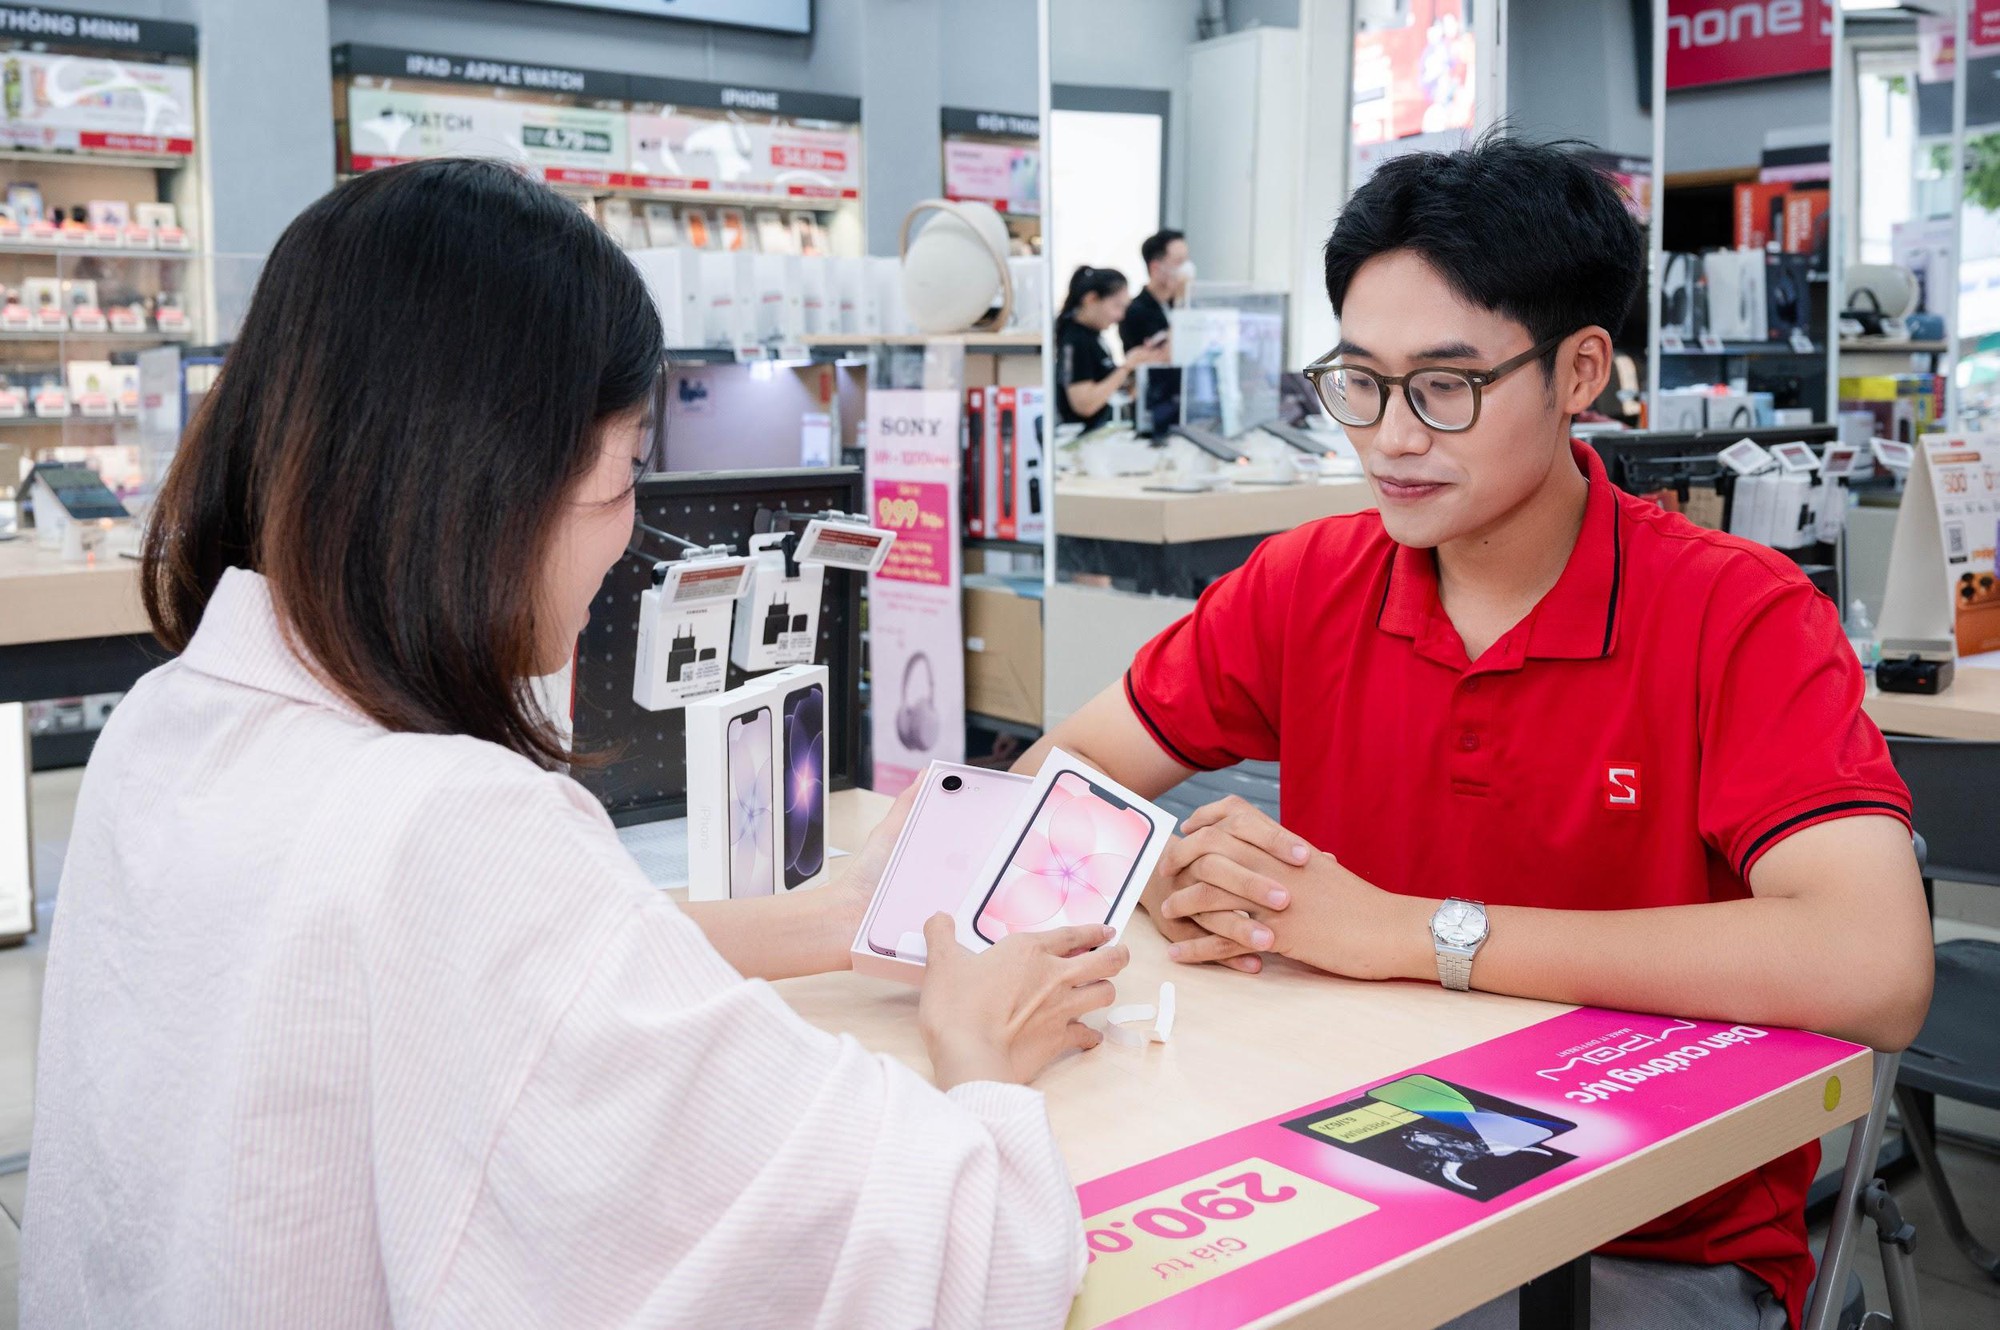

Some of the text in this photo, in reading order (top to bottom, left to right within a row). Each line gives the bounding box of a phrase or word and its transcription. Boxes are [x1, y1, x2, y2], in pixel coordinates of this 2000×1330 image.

[406, 54, 450, 78] IPAD
[463, 61, 522, 86] APPLE
[522, 67, 585, 92] WATCH
[721, 88, 779, 110] IPHONE
[880, 416, 942, 437] SONY
[1564, 1024, 1769, 1104] Dán cường lực
[1340, 1120, 1391, 1139] PREMIUM
[1087, 1172, 1298, 1265] 290.0
[1150, 1237, 1248, 1281] Giá từ
